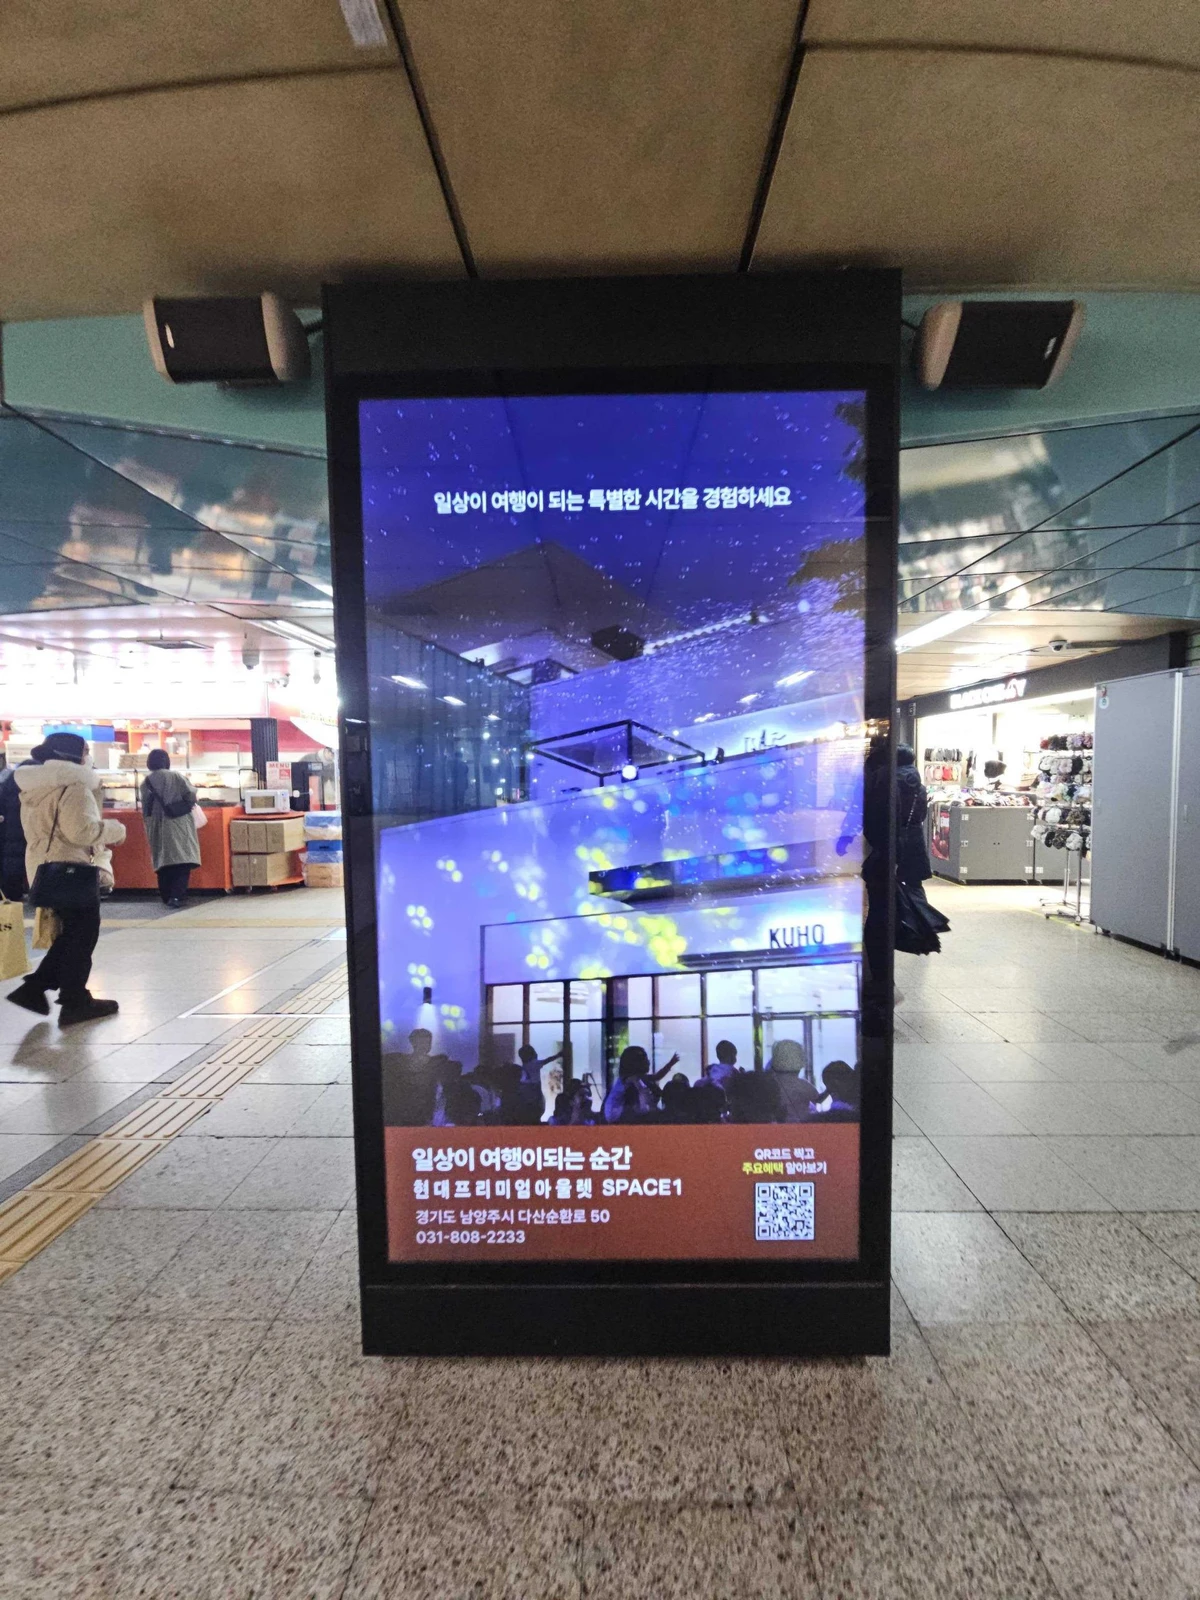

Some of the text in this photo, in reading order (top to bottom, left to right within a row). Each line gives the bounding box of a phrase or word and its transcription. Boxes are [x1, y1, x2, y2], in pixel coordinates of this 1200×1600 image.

[434, 485, 792, 514] 일상이 여행이 되는 특별한 시간을 경험하세요
[768, 924, 825, 950] KUHO
[411, 1145, 633, 1172] 일상이 여행이되는 순간
[754, 1147, 815, 1161] QR코드 찍고
[742, 1161, 828, 1175] 주요혜택 알아보기
[602, 1178, 682, 1196] SPACE1
[415, 1208, 610, 1225] 경기도 남양주시 다산순환로 50
[415, 1230, 526, 1244] 031-808-2233
